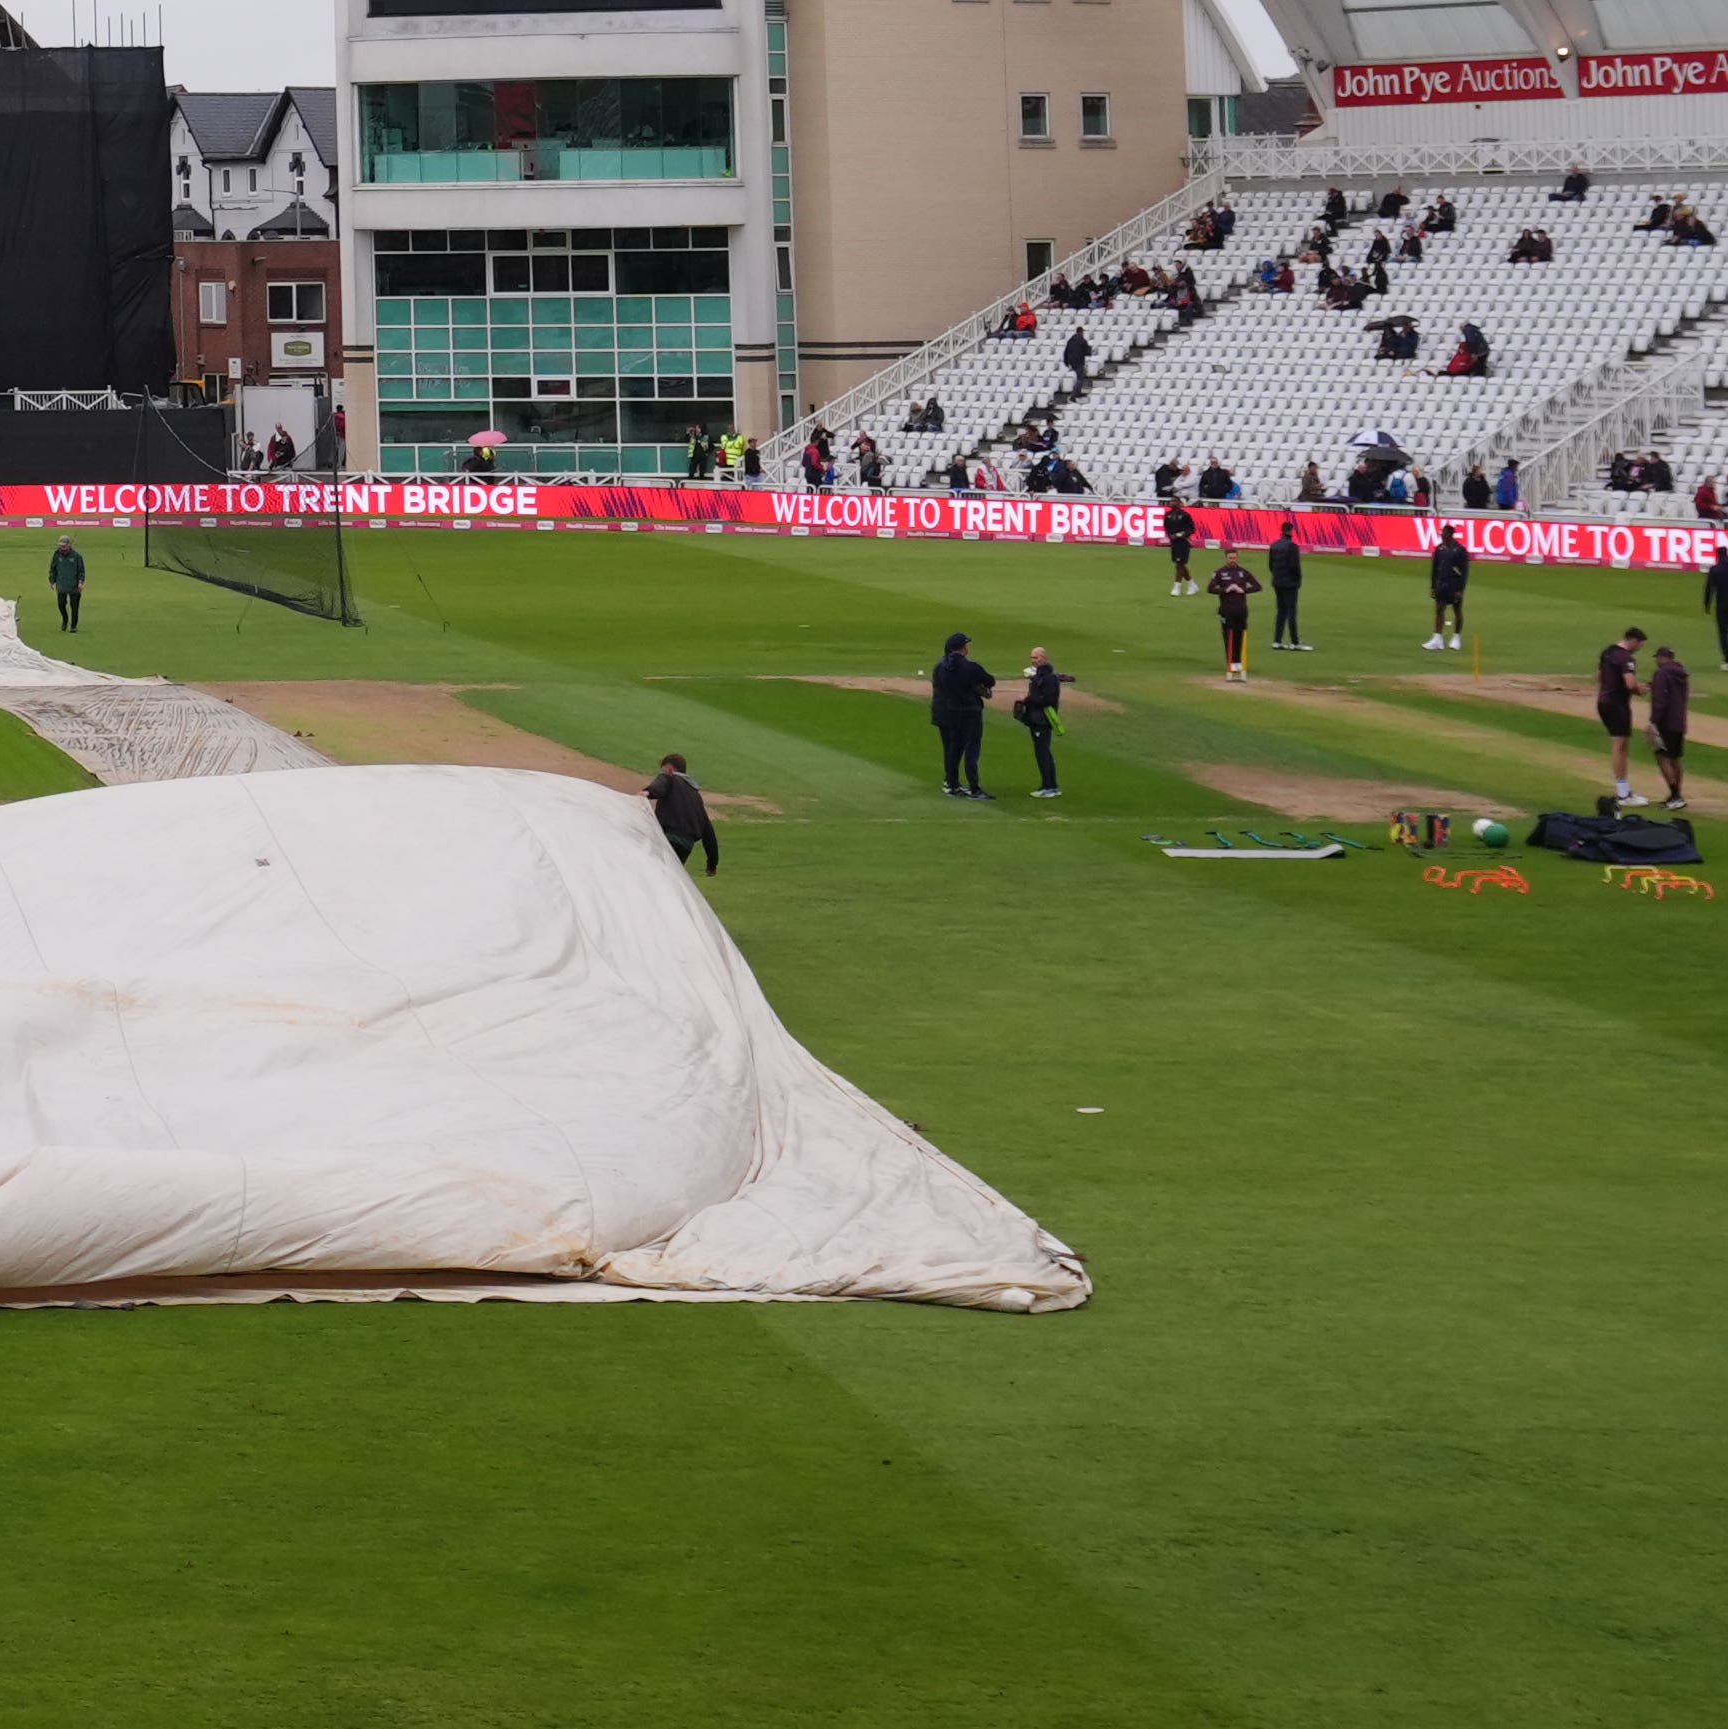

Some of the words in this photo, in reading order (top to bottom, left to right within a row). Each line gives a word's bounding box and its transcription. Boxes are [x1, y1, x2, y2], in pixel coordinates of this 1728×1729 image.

[1337, 69, 1400, 98] John
[1402, 67, 1451, 102] Pye
[1457, 62, 1560, 93] Auctions
[1582, 59, 1651, 88] John
[1653, 56, 1706, 94] Pye
[44, 483, 210, 513] WELCOME
[217, 484, 265, 512] TO
[277, 484, 392, 513] TRENT
[403, 485, 537, 514] BRIDGE
[771, 493, 898, 527] WELCOME
[903, 498, 941, 529] TO
[948, 500, 1042, 533] TRENT
[1051, 504, 1165, 538] BRIDGE
[1586, 526, 1635, 561] TO
